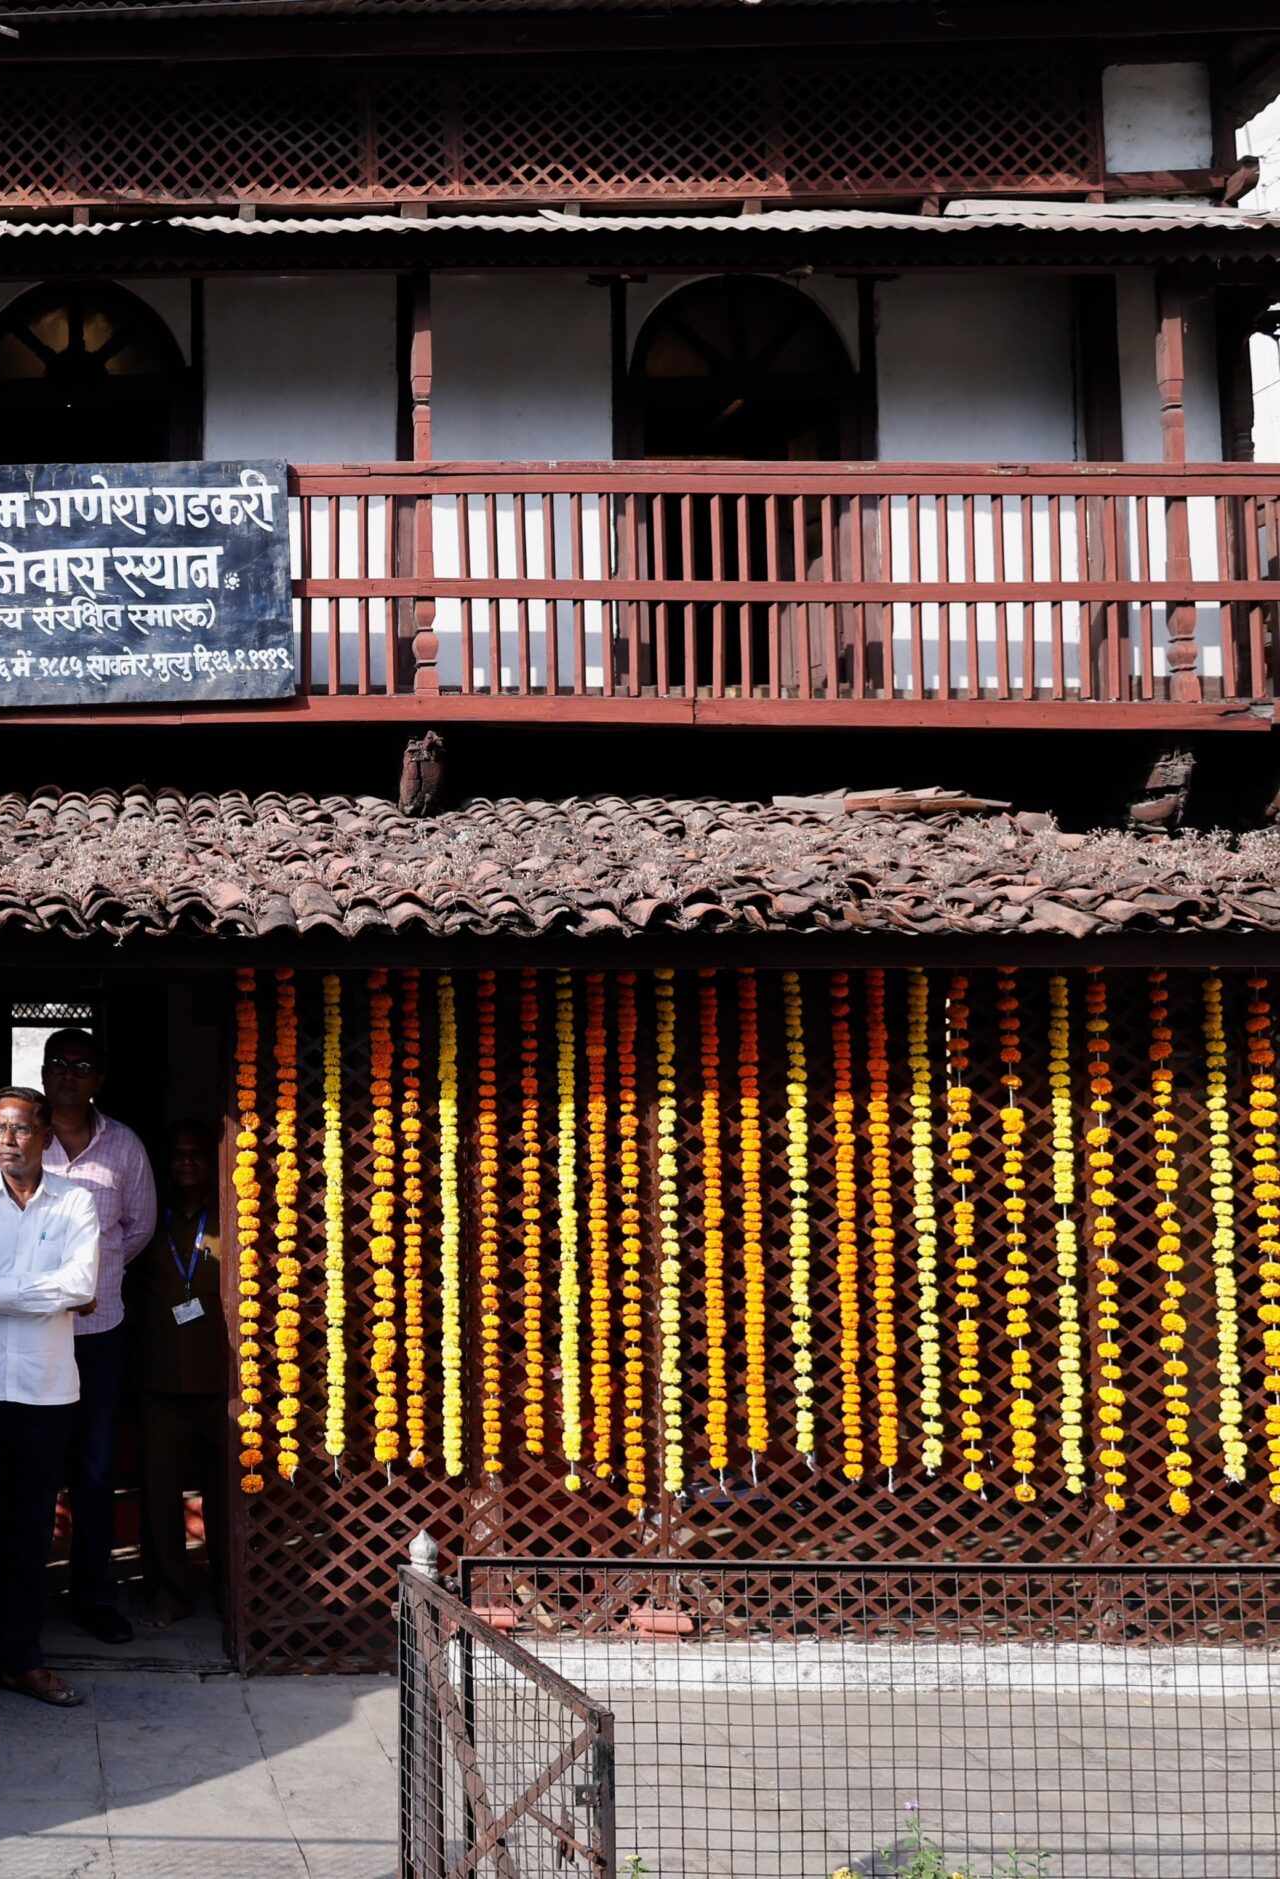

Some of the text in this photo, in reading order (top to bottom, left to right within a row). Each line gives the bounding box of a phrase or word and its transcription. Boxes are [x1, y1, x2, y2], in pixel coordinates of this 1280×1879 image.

[35, 475, 151, 535] गणेश
[153, 469, 280, 532] गडकरी
[112, 546, 224, 598] स्थान
[32, 597, 125, 635] संरक्षित
[127, 599, 215, 635] स्मारक)
